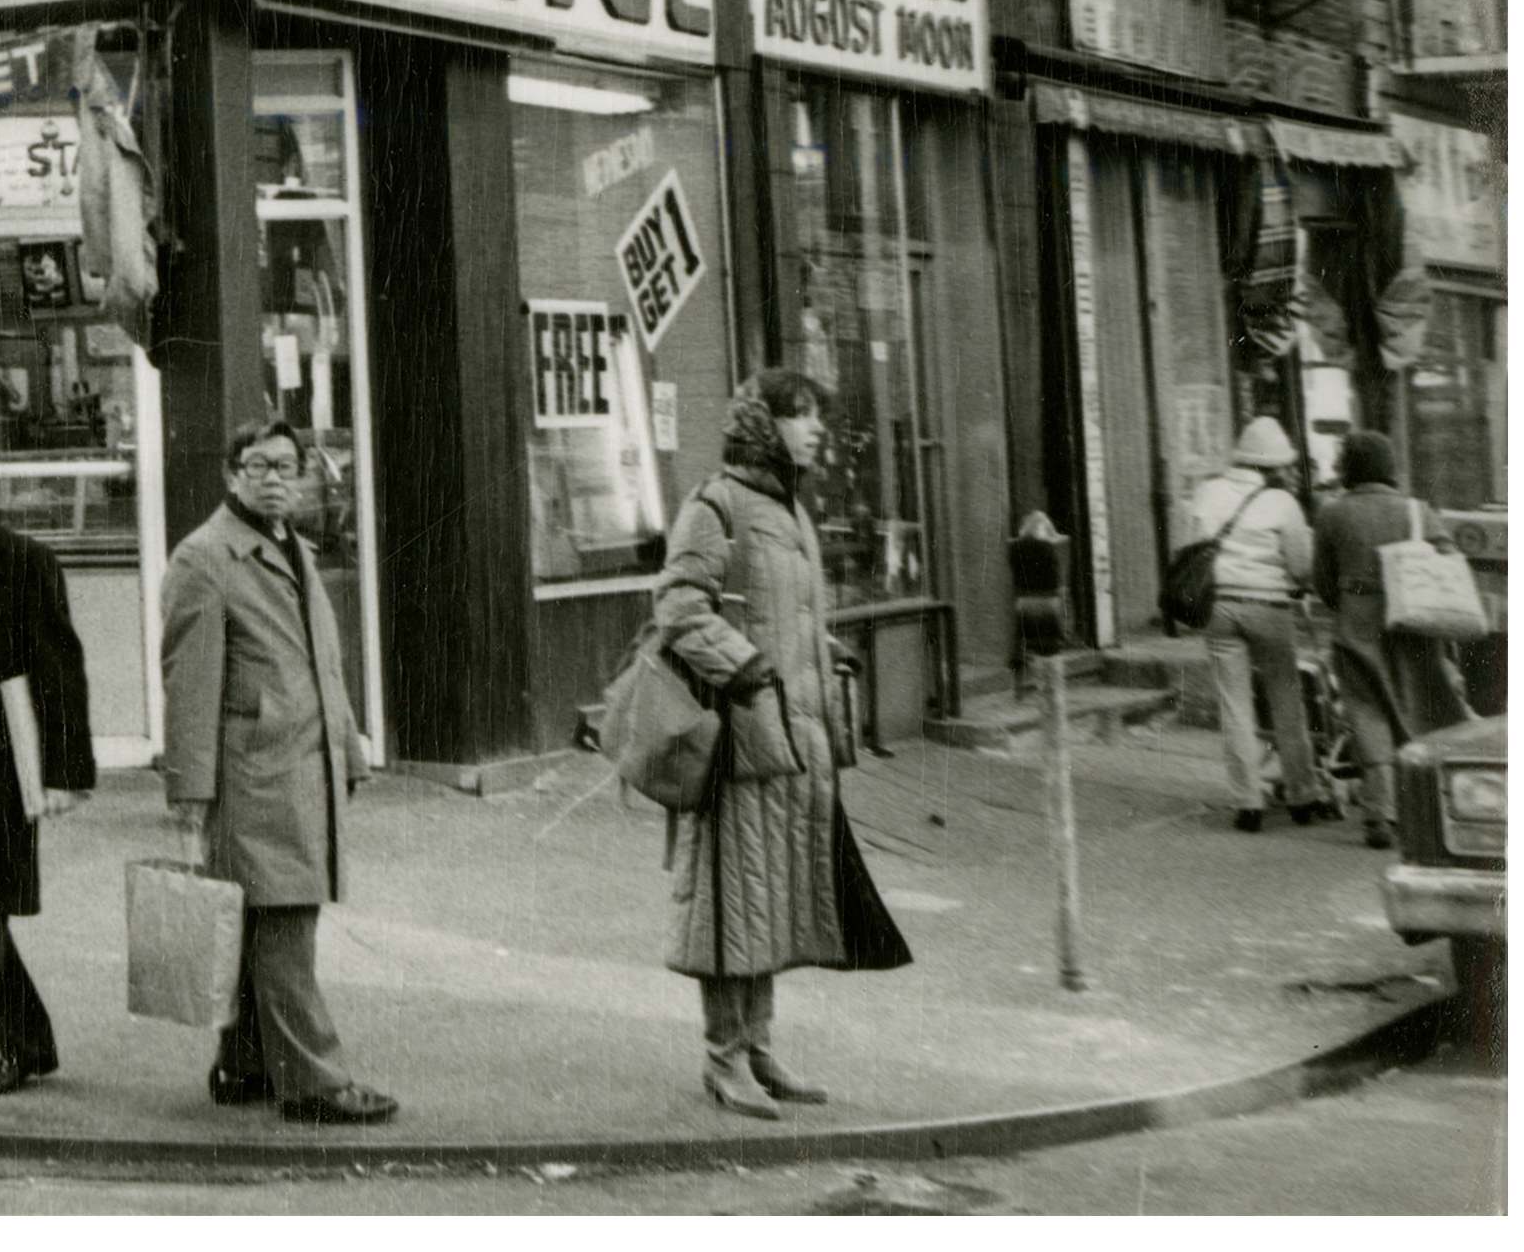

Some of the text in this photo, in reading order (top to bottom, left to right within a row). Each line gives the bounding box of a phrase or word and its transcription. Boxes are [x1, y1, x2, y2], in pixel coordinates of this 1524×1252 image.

[895, 5, 974, 71] MOON
[623, 205, 667, 290] BUY
[664, 187, 700, 277] 1
[637, 252, 680, 335] GET
[532, 312, 610, 416] FREE
